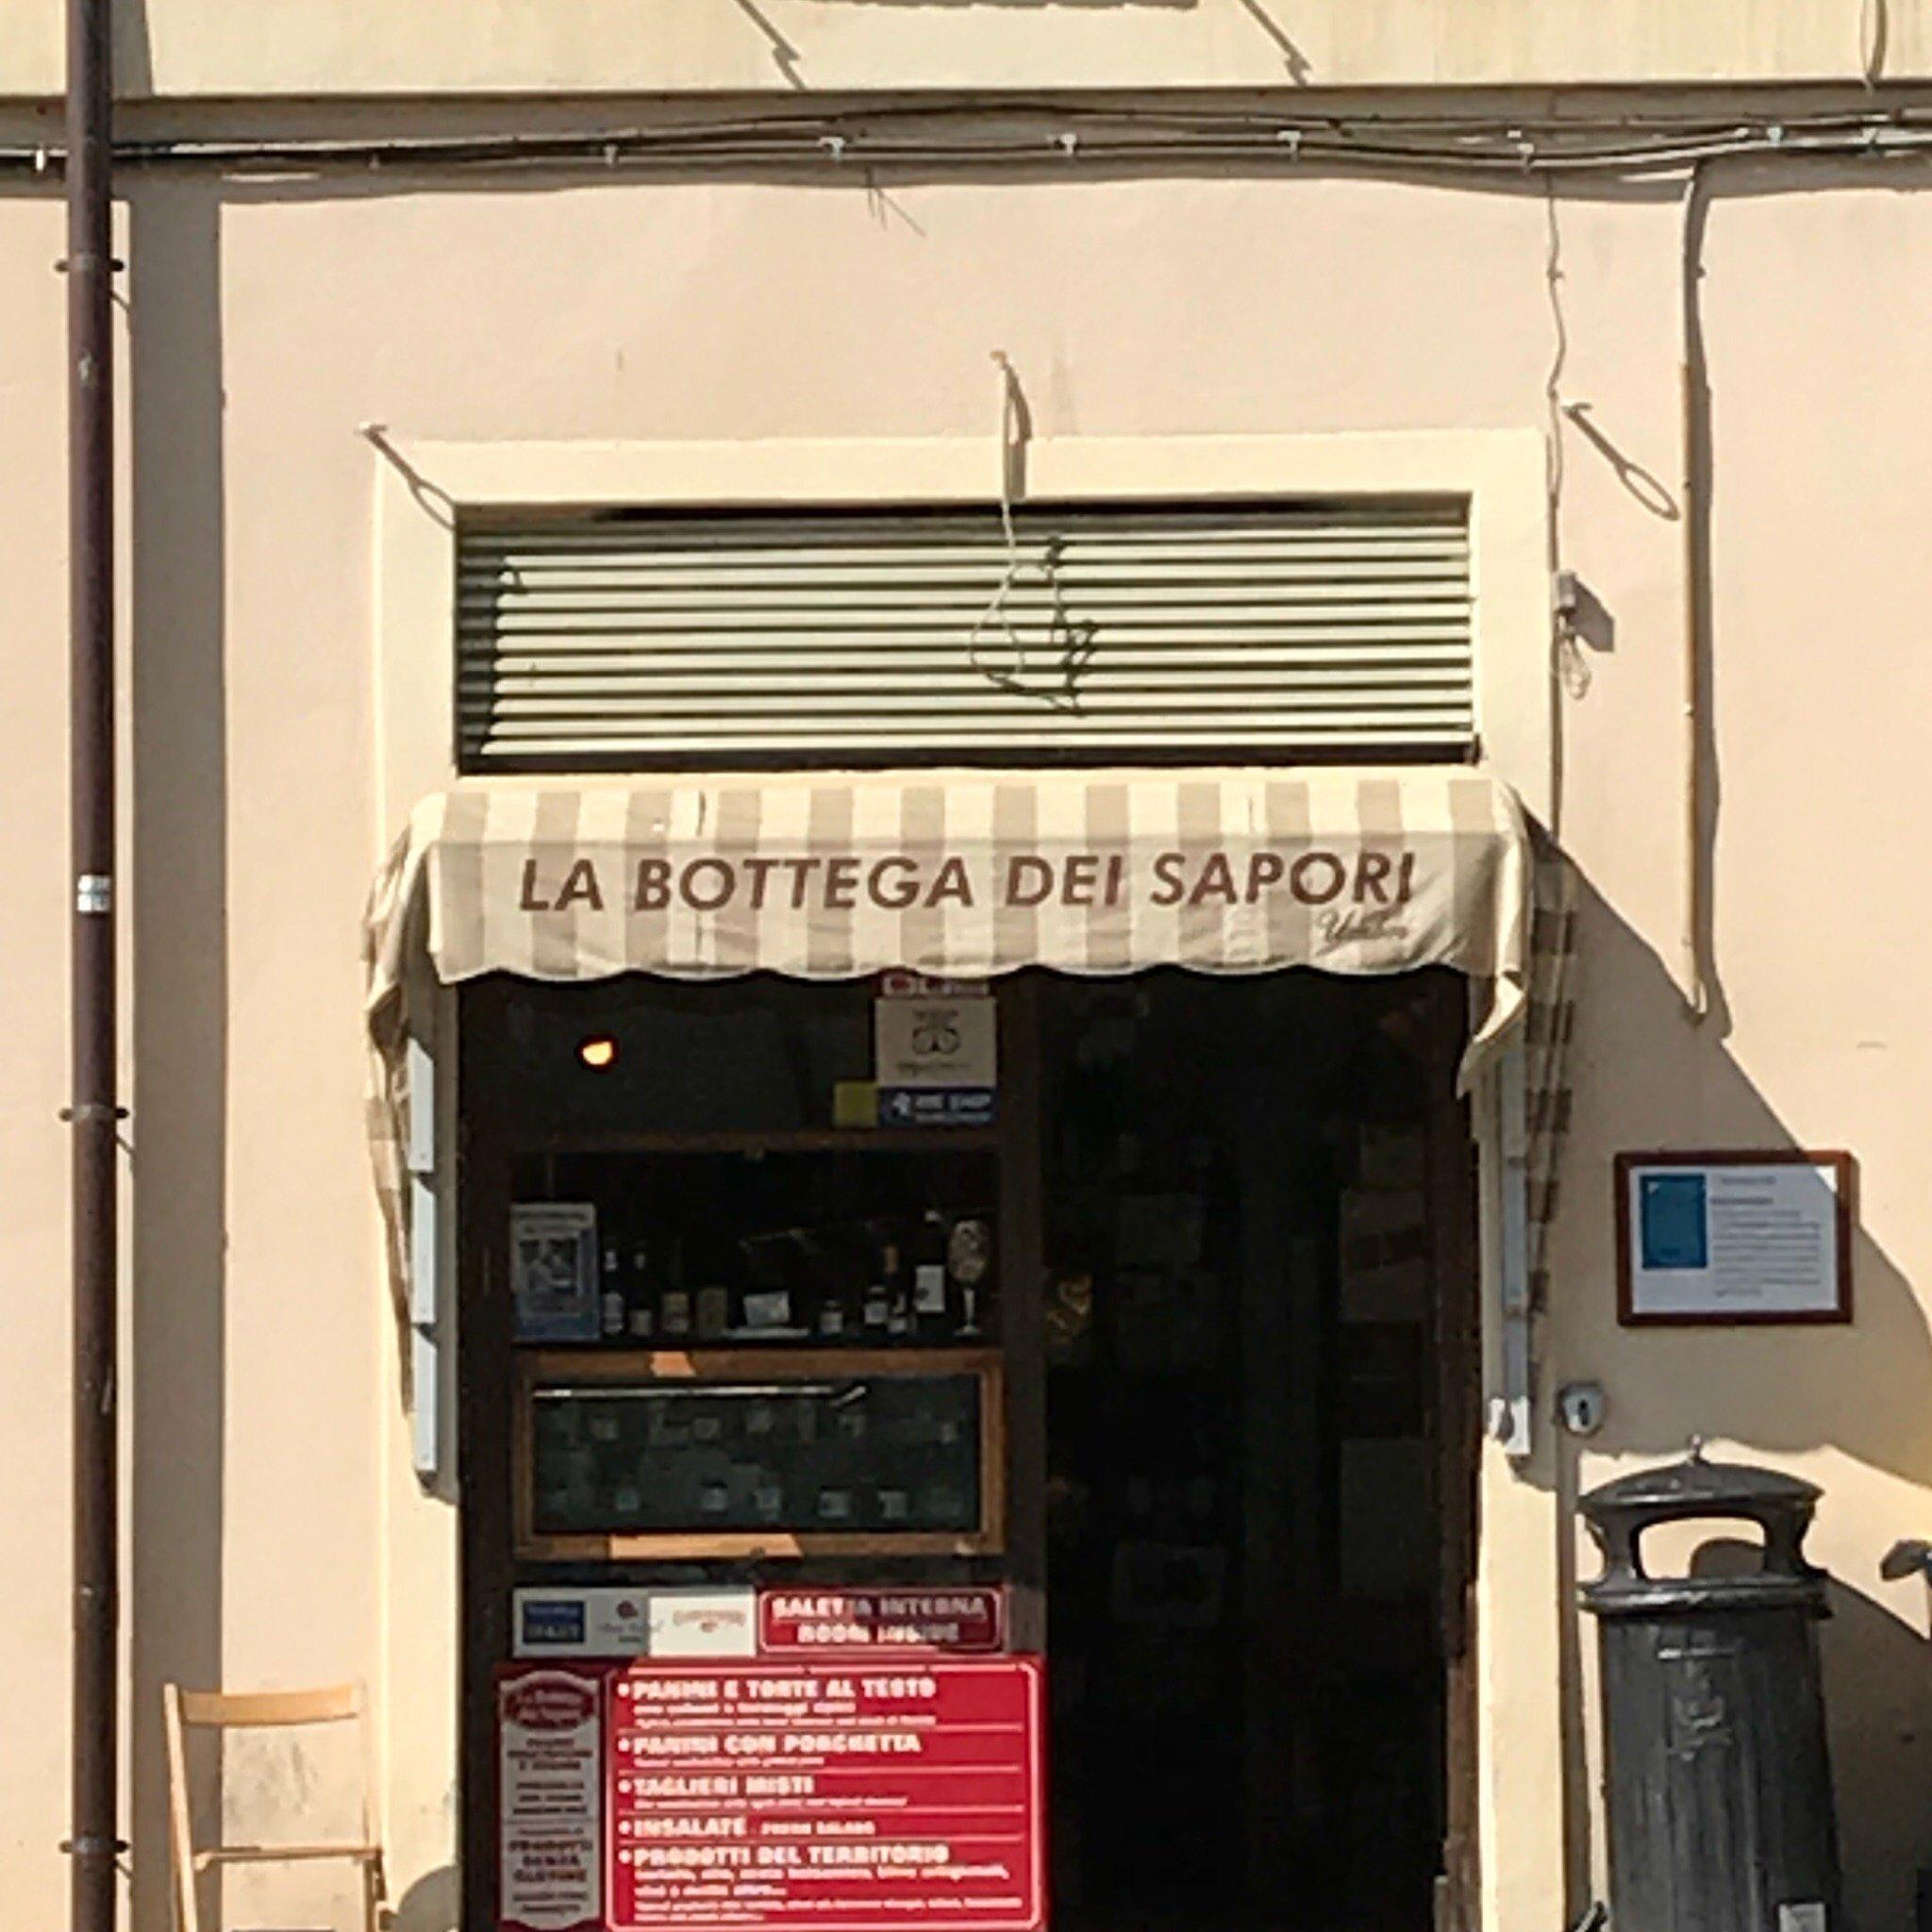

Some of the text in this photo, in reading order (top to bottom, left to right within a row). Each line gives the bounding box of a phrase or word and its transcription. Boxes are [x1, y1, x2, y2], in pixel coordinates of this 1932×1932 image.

[520, 851, 1415, 911] LA BOTTEGA DEI SAPORI
[633, 1677, 937, 1700] PANINI E TORTE AL TESTO
[724, 1735, 776, 1755] CON
[783, 1734, 922, 1753] PORCHETTA
[633, 1817, 747, 1838] INSALATE
[633, 1844, 950, 1867] PRODOTTI DEL TERRITORIO
